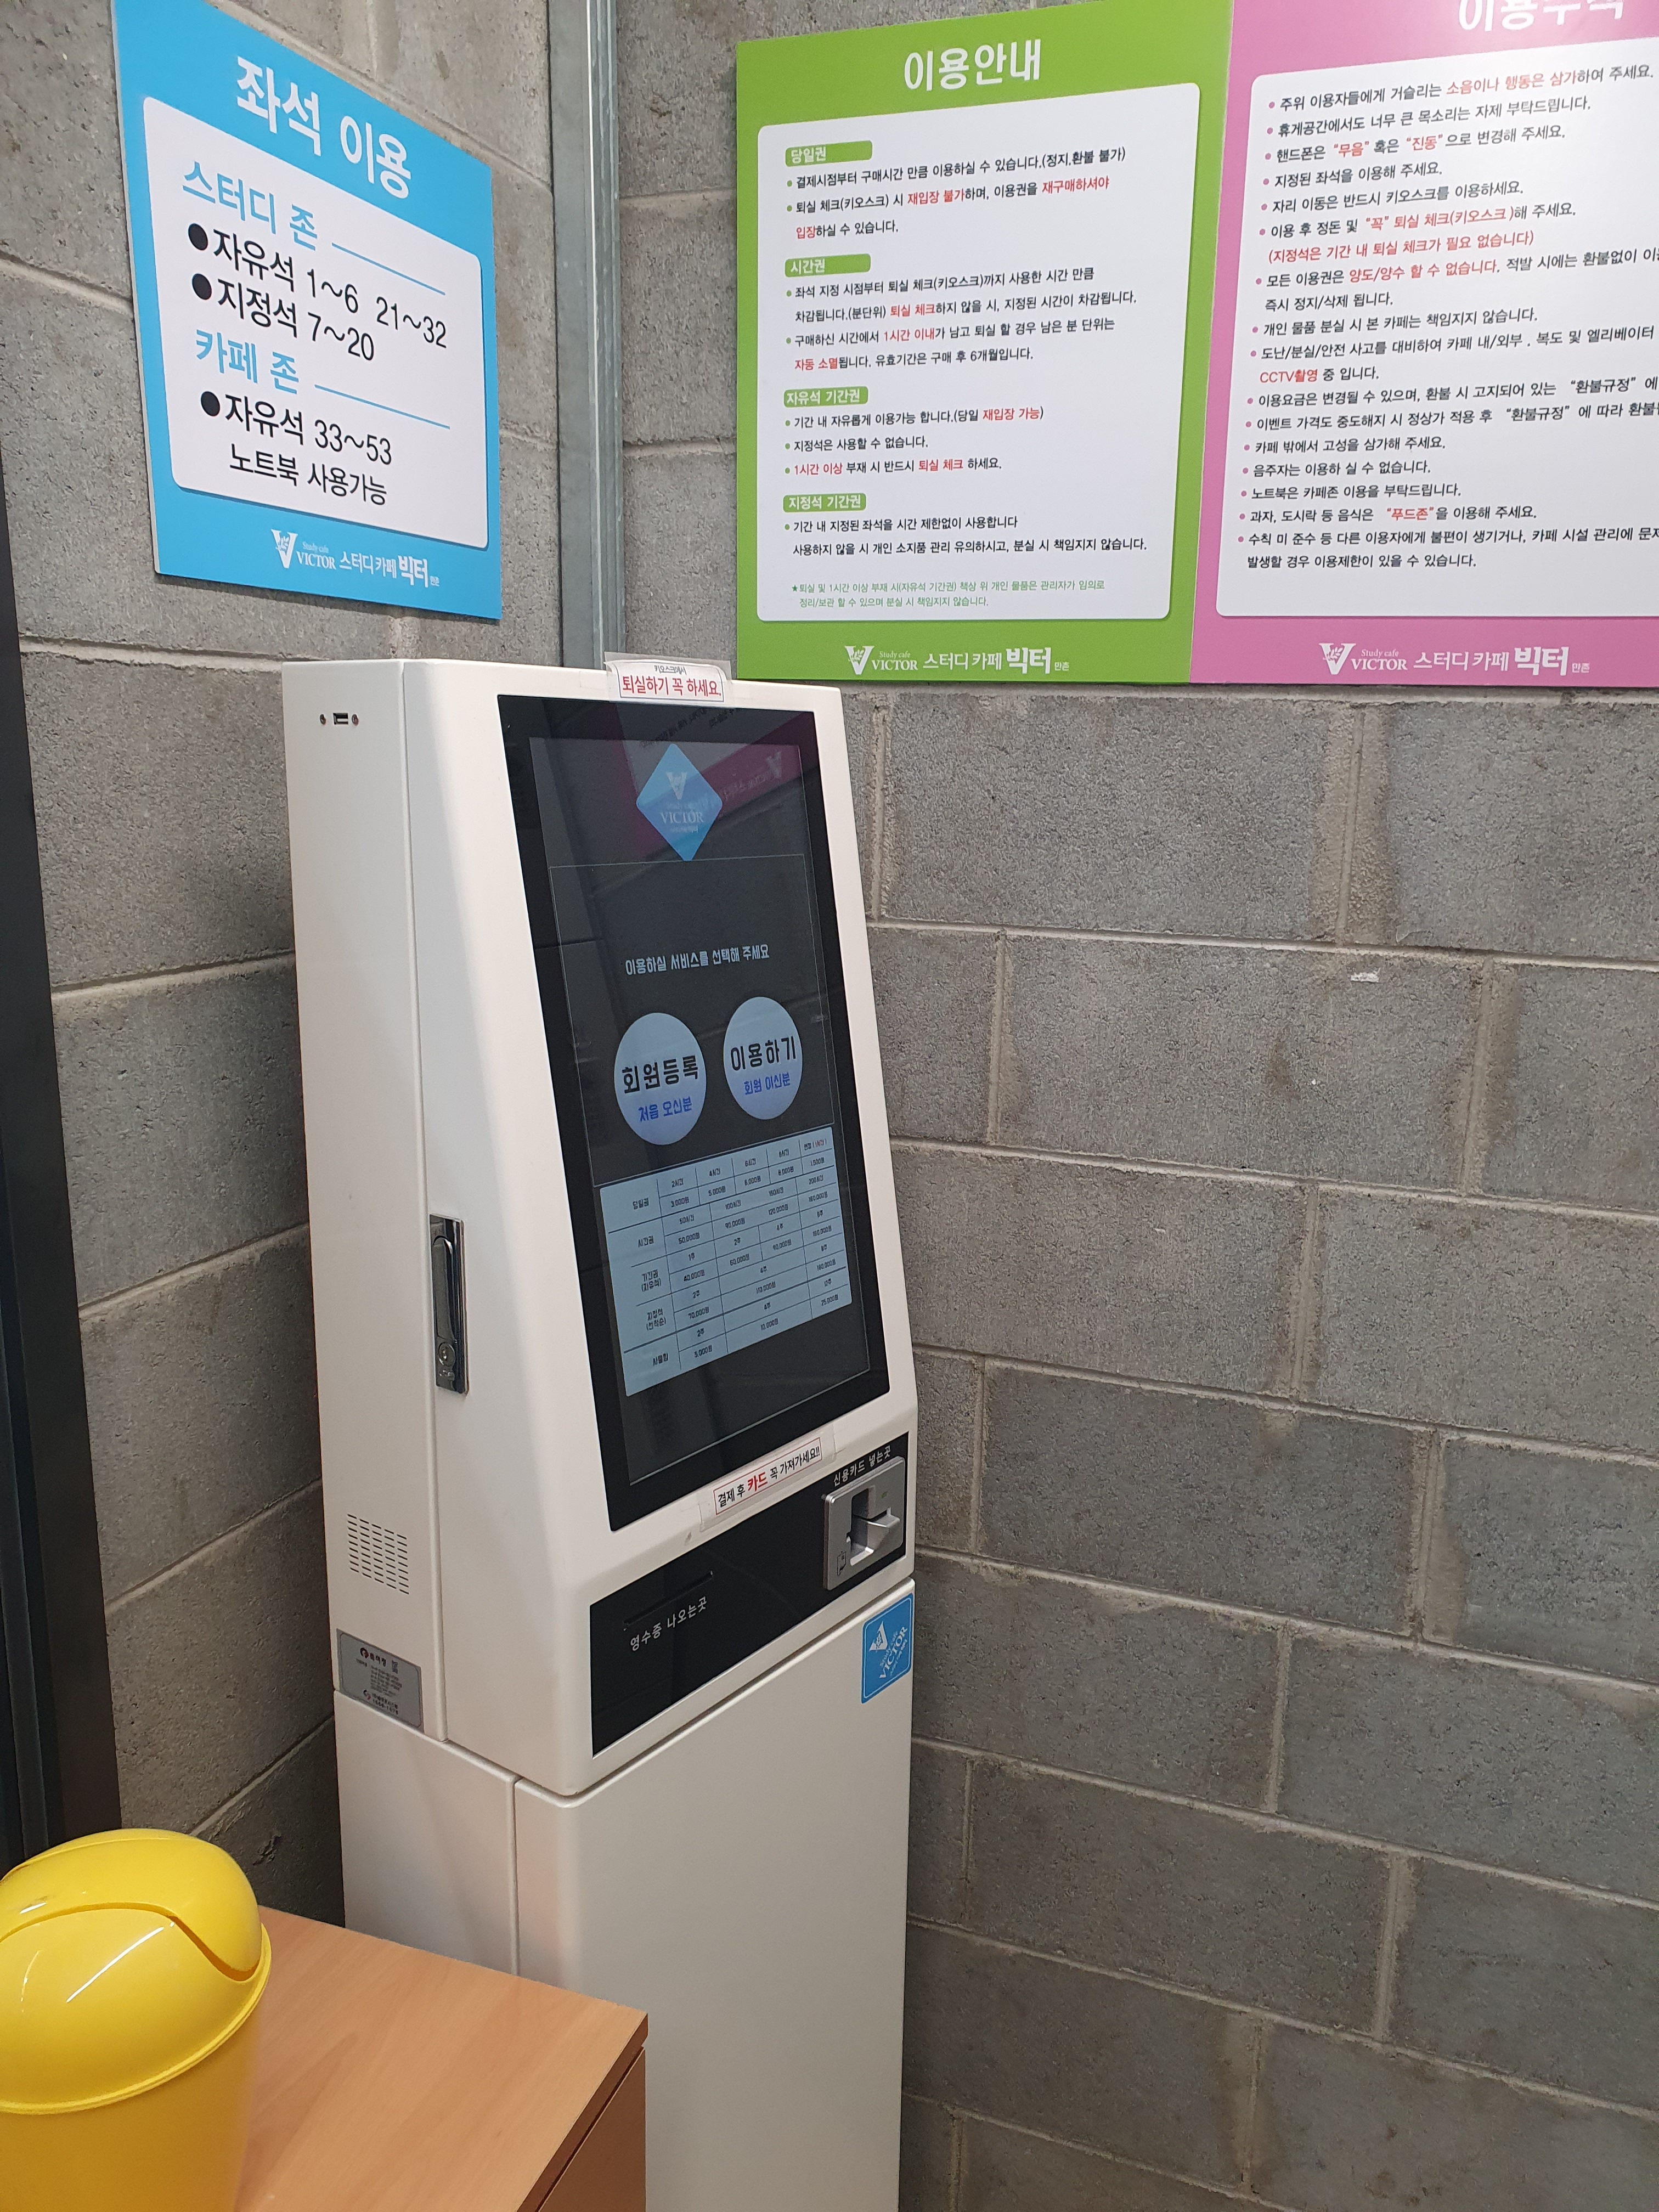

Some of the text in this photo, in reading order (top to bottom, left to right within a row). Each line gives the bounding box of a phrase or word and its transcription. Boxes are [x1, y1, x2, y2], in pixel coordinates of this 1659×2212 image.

[904, 38, 1042, 92] 이용안내
[236, 55, 412, 200] 좌석 이용
[1278, 95, 1590, 138] 휴게공간에서도 너무 큰 목소리는 자제 부탁드립니다.
[790, 146, 826, 164] 당일권
[797, 171, 857, 189] 결제시점부터
[861, 167, 904, 184] 구매시간
[907, 166, 928, 180] 만큼
[933, 161, 975, 177] 이용하실
[980, 160, 990, 173] 수
[1099, 146, 1125, 163] 불가)
[1274, 162, 1442, 188] 지정된 좌석을 이용해 주세요.
[182, 161, 318, 251] 스터디 존
[796, 176, 1109, 213] 퇴실 체크(키오스크) 시 재입장 불가하며, 이용권을 재구매하셔야
[1272, 181, 1523, 213] 자리 이동은 반드시 키오스크를 이용하세요.
[797, 219, 899, 239] 입장하실 수 있습니다.
[791, 258, 825, 275] 시간권
[307, 268, 358, 314] 1~6
[376, 296, 446, 348] 21~32
[308, 312, 374, 361] 7~20
[196, 329, 299, 395] 카페 존
[1260, 366, 1379, 383] CCTV촬영 중 입니다.
[786, 388, 862, 405] 자유석 기간권
[795, 416, 814, 428] 기간
[818, 415, 826, 427] 내
[831, 414, 871, 427] 자유롭게
[876, 412, 916, 425] 이용가능
[983, 408, 1014, 421] 재입장
[1019, 406, 1043, 420] 가능)
[315, 419, 392, 465] 33~53
[794, 436, 928, 452] 지정석은 사용할 수 없습니다.
[1255, 436, 1445, 454] 카페 밖에서 고성을 삼가해 주세요.
[230, 443, 387, 505] 노트북 사용가능
[1254, 464, 1301, 477] 음주자는
[1362, 462, 1374, 475] 수
[1379, 460, 1431, 474] 없습니다.
[788, 494, 860, 510] 지정석 기간권
[1251, 483, 1461, 499] 노트북은 카페존 이용을 부탁드립니다.
[296, 550, 337, 571] VICTOR
[339, 551, 374, 575] 스터디
[375, 556, 397, 579] 카페
[398, 555, 429, 589] 빅터
[800, 596, 989, 608] 정리/보관 할 수 있으며 분실 시 책임지지 않습니다.
[872, 659, 918, 671] VICTOR
[879, 650, 898, 659] Study
[922, 652, 969, 671] 스터디
[971, 652, 1002, 671] 카페
[1006, 647, 1052, 675] 빅터
[1351, 658, 1408, 672] VICTOR
[1361, 648, 1400, 659] Study cafe
[1413, 651, 1468, 672] 스터디
[1471, 651, 1510, 672] 카페
[1514, 646, 1570, 676] 빅터
[654, 664, 687, 676] 키오스크에서
[622, 675, 722, 697] 퇴실하기 꼭 하세요.
[660, 811, 704, 824] VICTOR
[625, 944, 770, 975] 이용하실 서비스를 선택해 주세요
[730, 1035, 797, 1071] 이용하기
[621, 1054, 699, 1094] 회원등록
[744, 1073, 791, 1096] 회원 이신분
[638, 1096, 692, 1122] 처음 오신분
[718, 1446, 821, 1508] 결제 후 카드 꼭 가져가세요!!
[833, 1458, 866, 1487] 신용카드
[629, 1622, 663, 1652] 영수증
[879, 1626, 909, 1679] VICTOR
